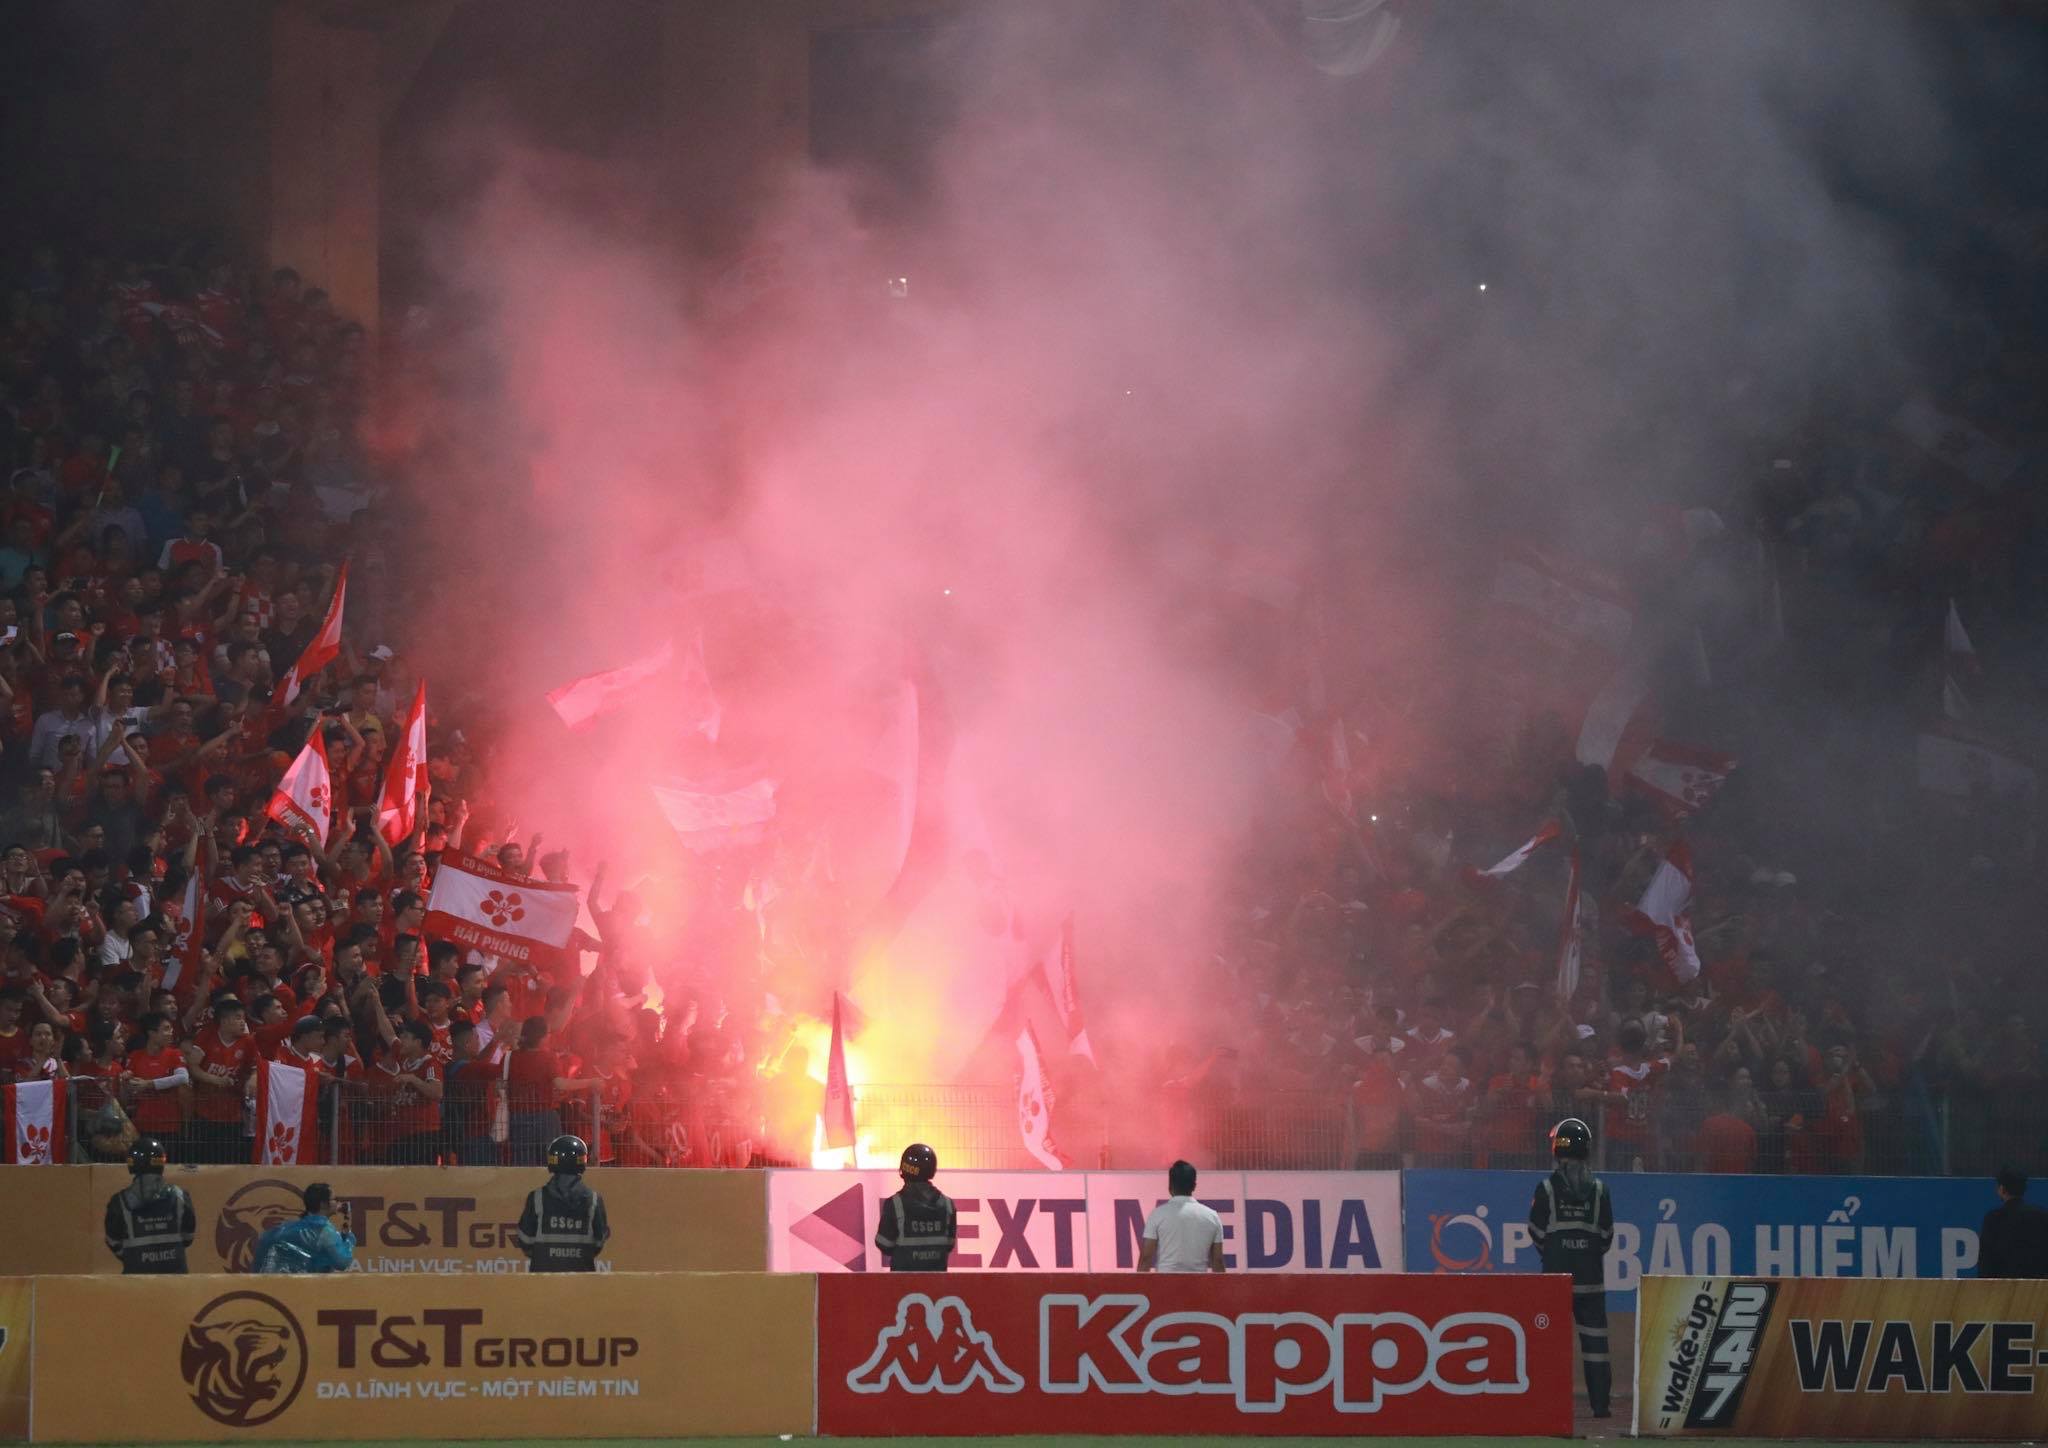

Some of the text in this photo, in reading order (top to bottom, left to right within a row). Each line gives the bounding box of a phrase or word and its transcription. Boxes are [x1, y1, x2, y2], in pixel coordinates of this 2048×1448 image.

[335, 1197, 476, 1249] T&T
[1755, 1196, 1918, 1278] HIỂM
[141, 1249, 177, 1262] POLICE
[549, 1247, 581, 1258] POLICE
[317, 1308, 639, 1368] T&T GROUP
[1039, 1294, 1530, 1413] Kappa
[316, 1380, 352, 1398] ĐA
[356, 1376, 411, 1398] LĨNH
[417, 1378, 466, 1401] VỰC
[483, 1376, 535, 1400] MỘT
[538, 1376, 597, 1397] NIỀM
[600, 1379, 639, 1396] TIN
